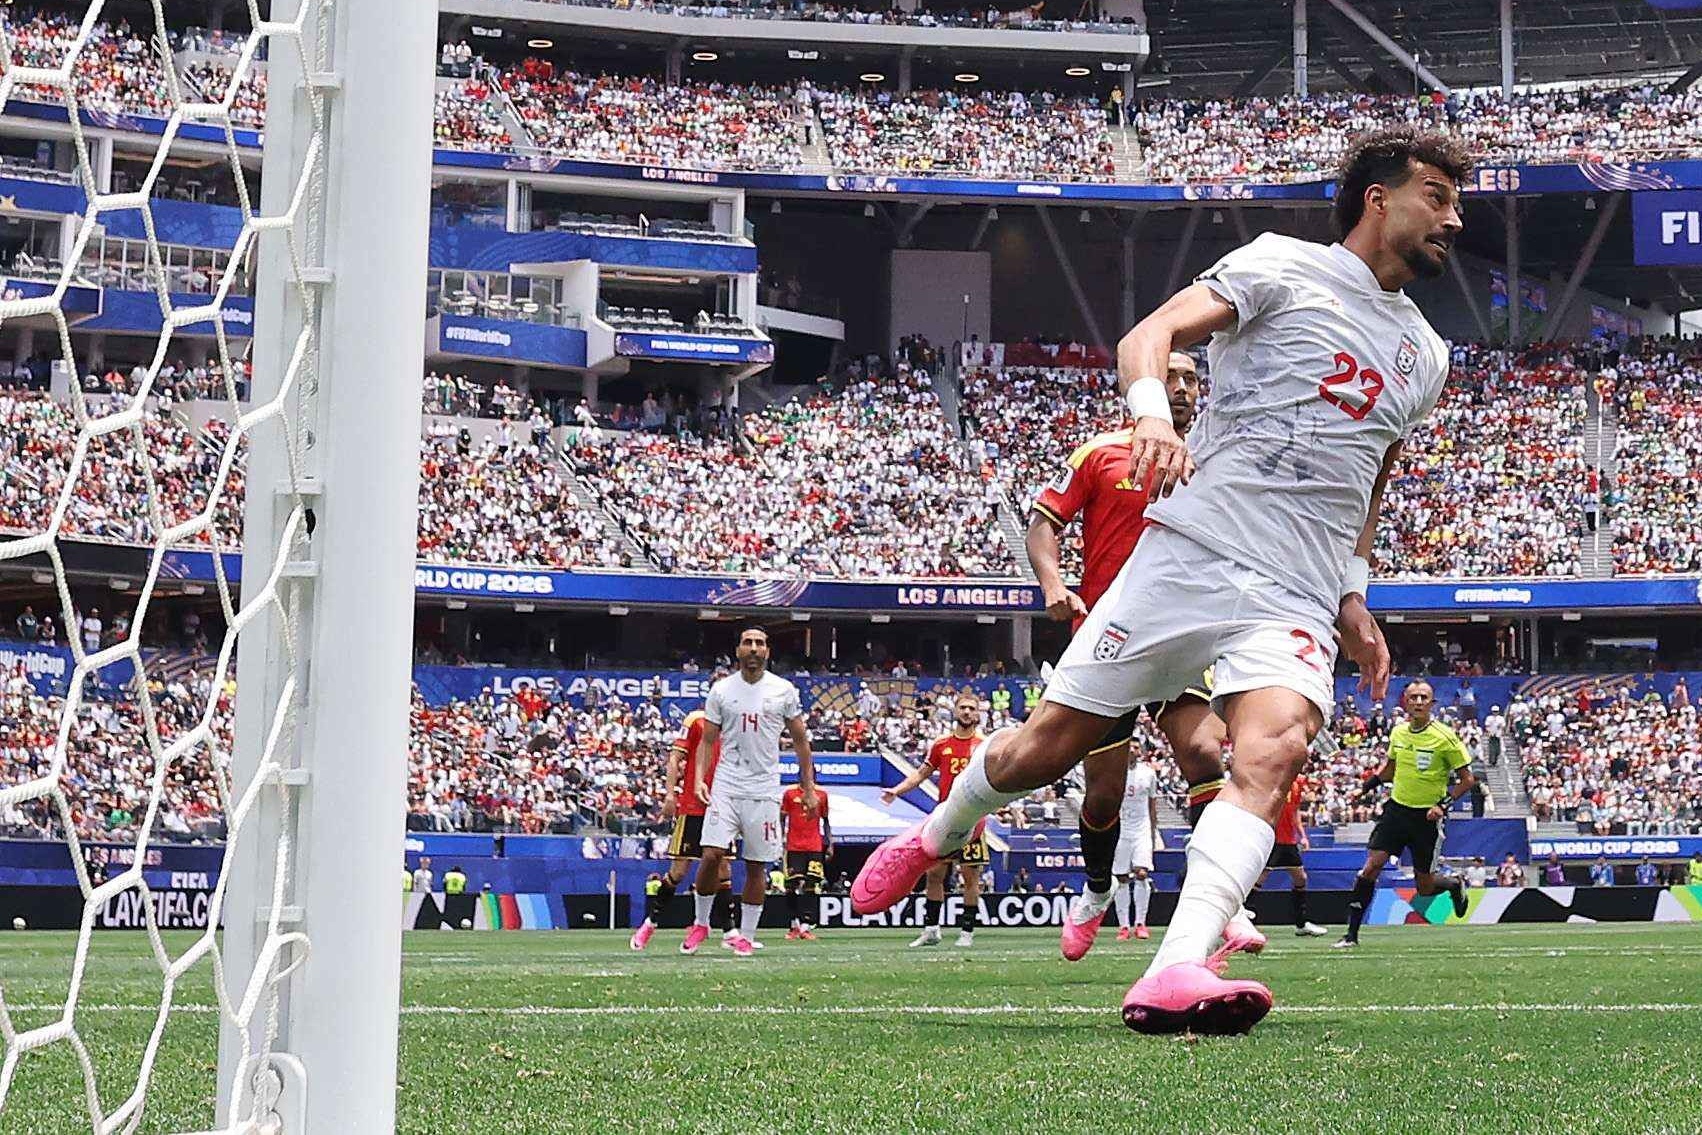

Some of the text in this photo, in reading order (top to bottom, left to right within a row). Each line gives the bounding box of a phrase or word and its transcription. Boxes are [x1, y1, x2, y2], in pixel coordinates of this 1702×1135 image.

[642, 168, 718, 183] LOS ANGELES
[1319, 351, 1384, 420] 23
[450, 571, 486, 590] CUP
[487, 574, 552, 593] 2026
[898, 588, 1033, 605] LOS ANGELES
[742, 713, 758, 733] 14
[963, 842, 982, 860] 23
[1553, 842, 1602, 855] WORLD
[1604, 842, 1631, 854] CUP
[1631, 841, 1680, 854] 2026
[1036, 855, 1064, 867] LOS
